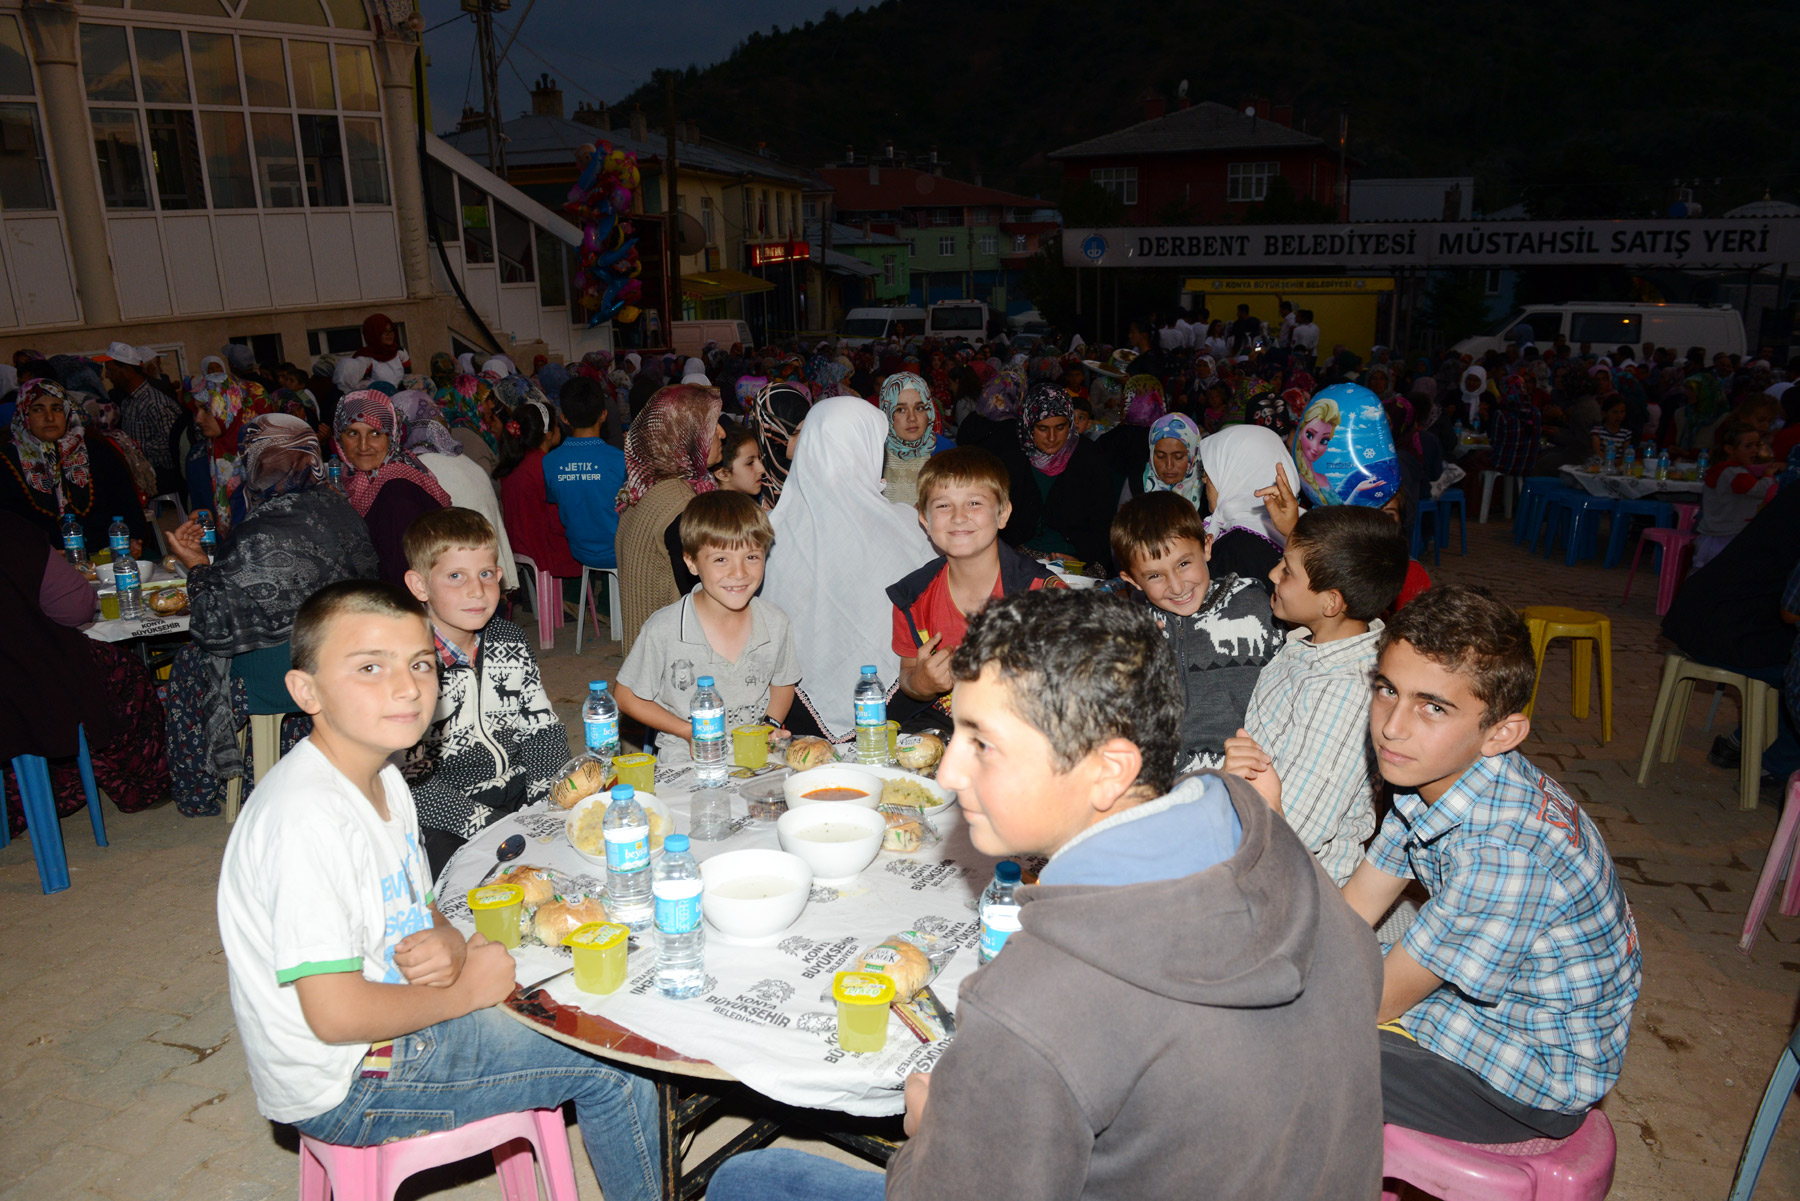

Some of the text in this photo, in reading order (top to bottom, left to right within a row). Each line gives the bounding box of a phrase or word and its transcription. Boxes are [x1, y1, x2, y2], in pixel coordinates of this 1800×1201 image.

[1138, 236, 1250, 257] DERBENT
[1264, 229, 1417, 255] BELEDİYESİ
[1439, 226, 1600, 254] MÜSTAHSİL
[1611, 229, 1690, 259] SATIŞ
[1704, 225, 1770, 252] YERİ
[1225, 281, 1251, 289] KONYA
[565, 462, 592, 471] JETIX
[557, 473, 601, 482] SPORT WEAR
[141, 620, 166, 629] KONYA
[910, 864, 934, 880] KONYA
[736, 994, 777, 1010] KONYA
[704, 995, 791, 1028] BÜYÜKŞEHİR
